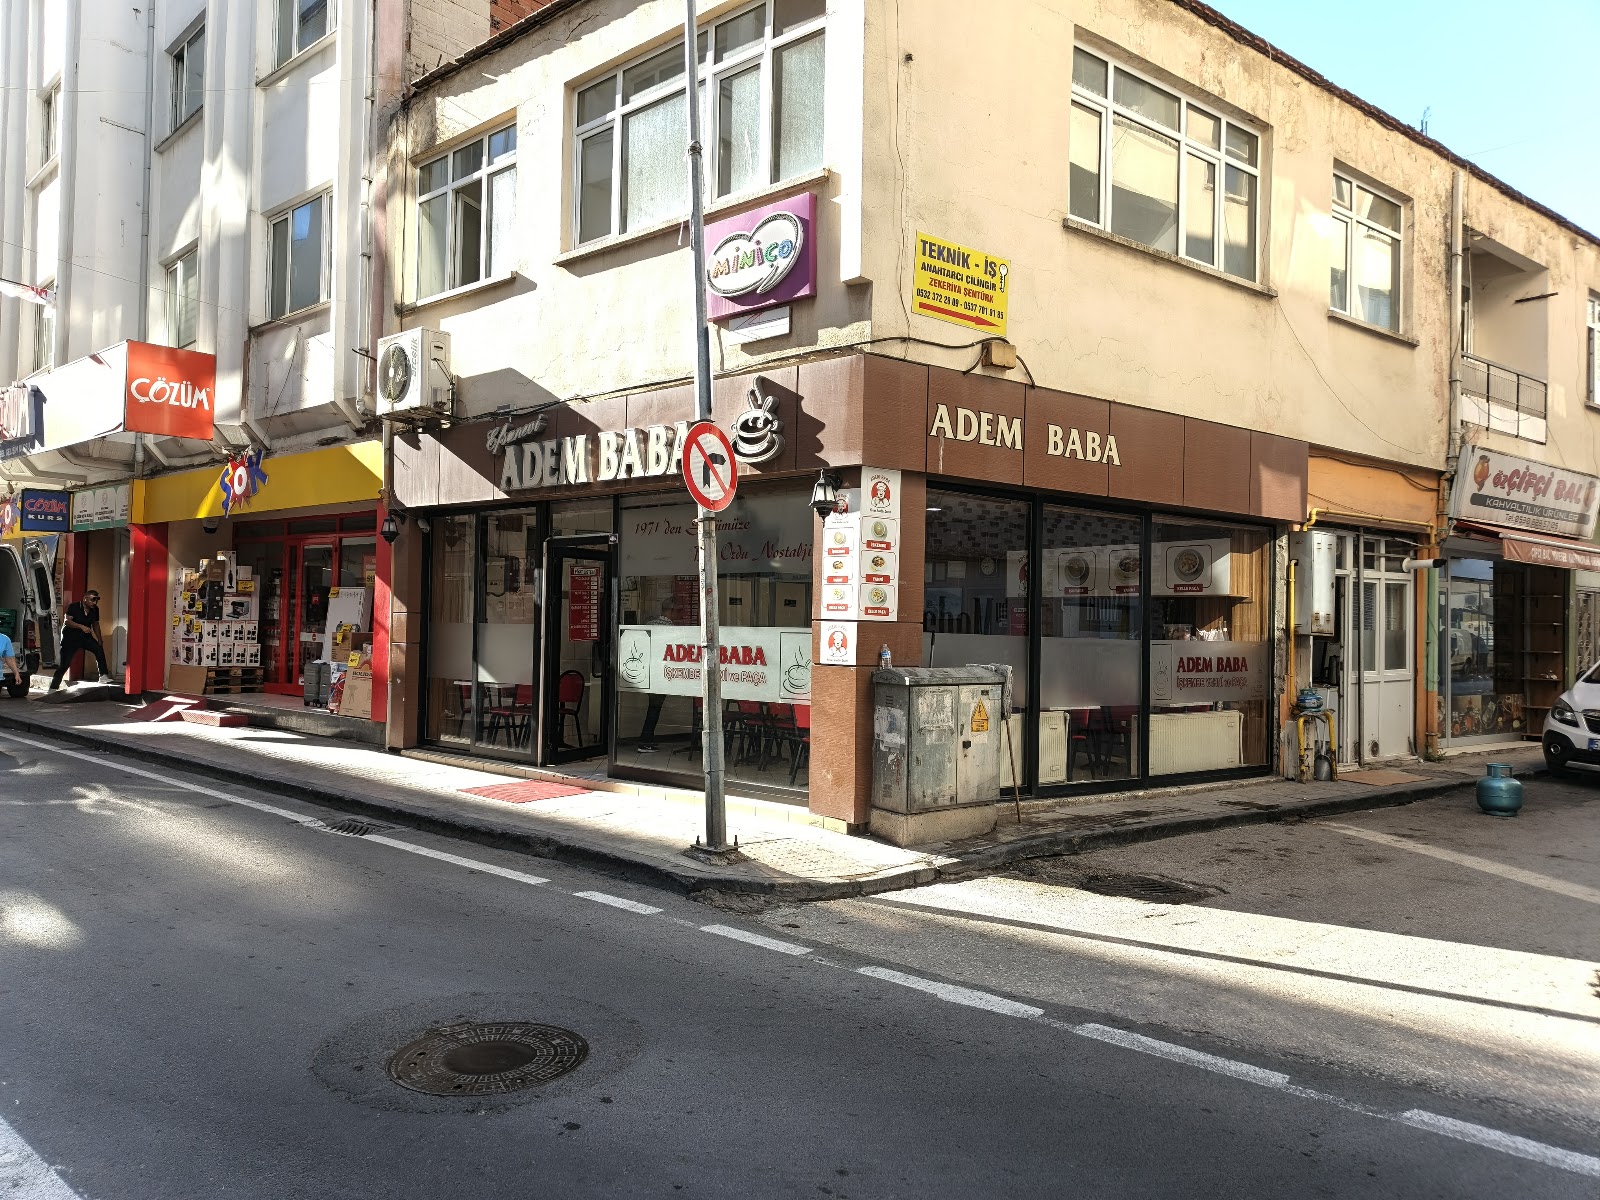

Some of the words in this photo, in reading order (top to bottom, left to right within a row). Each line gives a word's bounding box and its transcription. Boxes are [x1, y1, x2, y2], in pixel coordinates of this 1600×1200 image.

[920, 238, 971, 270] TEKNİK
[984, 256, 997, 280] İŞ
[921, 261, 964, 282] ANAHTARCI
[916, 287, 931, 302] 0532
[928, 276, 962, 295] ZEKERİYA
[963, 287, 994, 304] ŞENTÜRK
[130, 377, 210, 410] ÇÖZÜM
[929, 403, 1024, 451] ADEM
[1046, 423, 1122, 467] BABA
[500, 433, 593, 492] ADEM
[597, 420, 691, 481] BABA
[1553, 479, 1583, 505] BAL
[1485, 497, 1542, 515] KAHVALTILIK
[1542, 508, 1579, 522] ÜRÜNLER
[719, 645, 768, 666] BABA
[1176, 656, 1214, 673] ADEM
[1215, 656, 1249, 673] BABA
